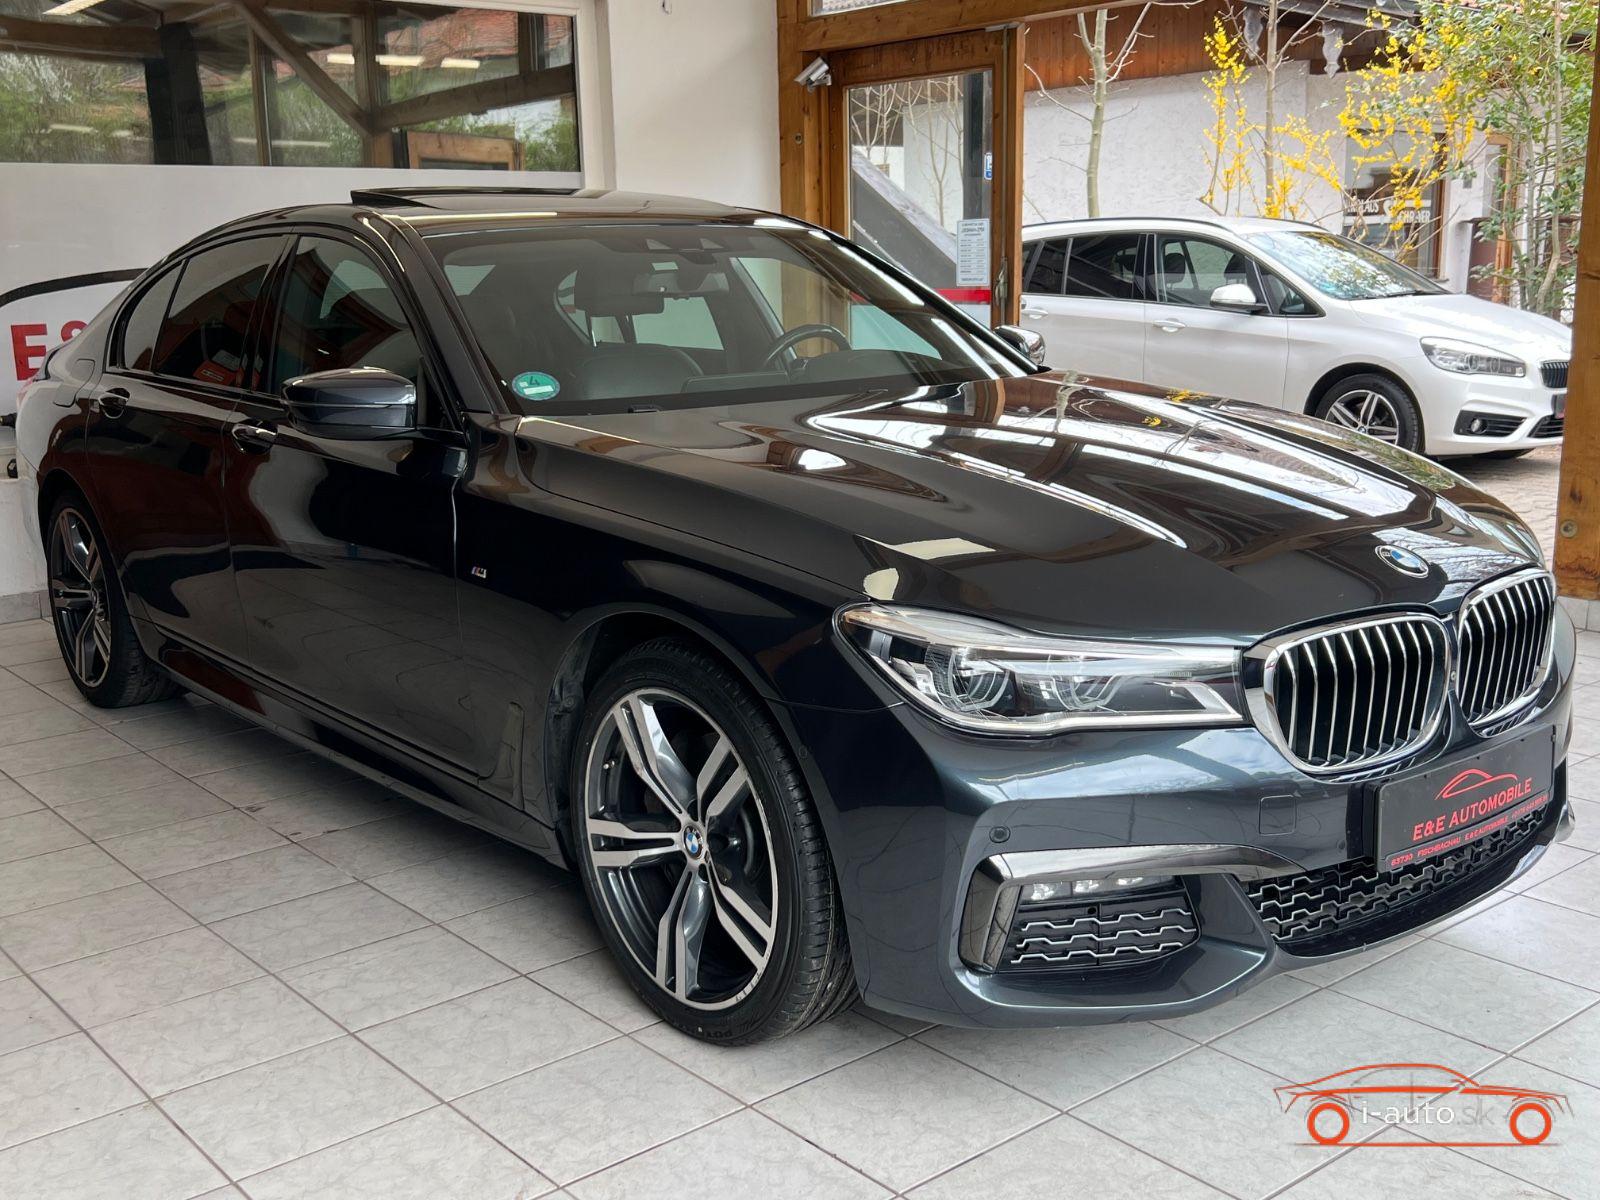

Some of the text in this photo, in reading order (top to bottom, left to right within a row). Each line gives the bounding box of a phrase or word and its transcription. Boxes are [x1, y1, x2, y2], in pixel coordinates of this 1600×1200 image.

[529, 375, 541, 386] 4
[1412, 815, 1446, 842] E&E
[1448, 777, 1533, 829] AUTOMOBILE
